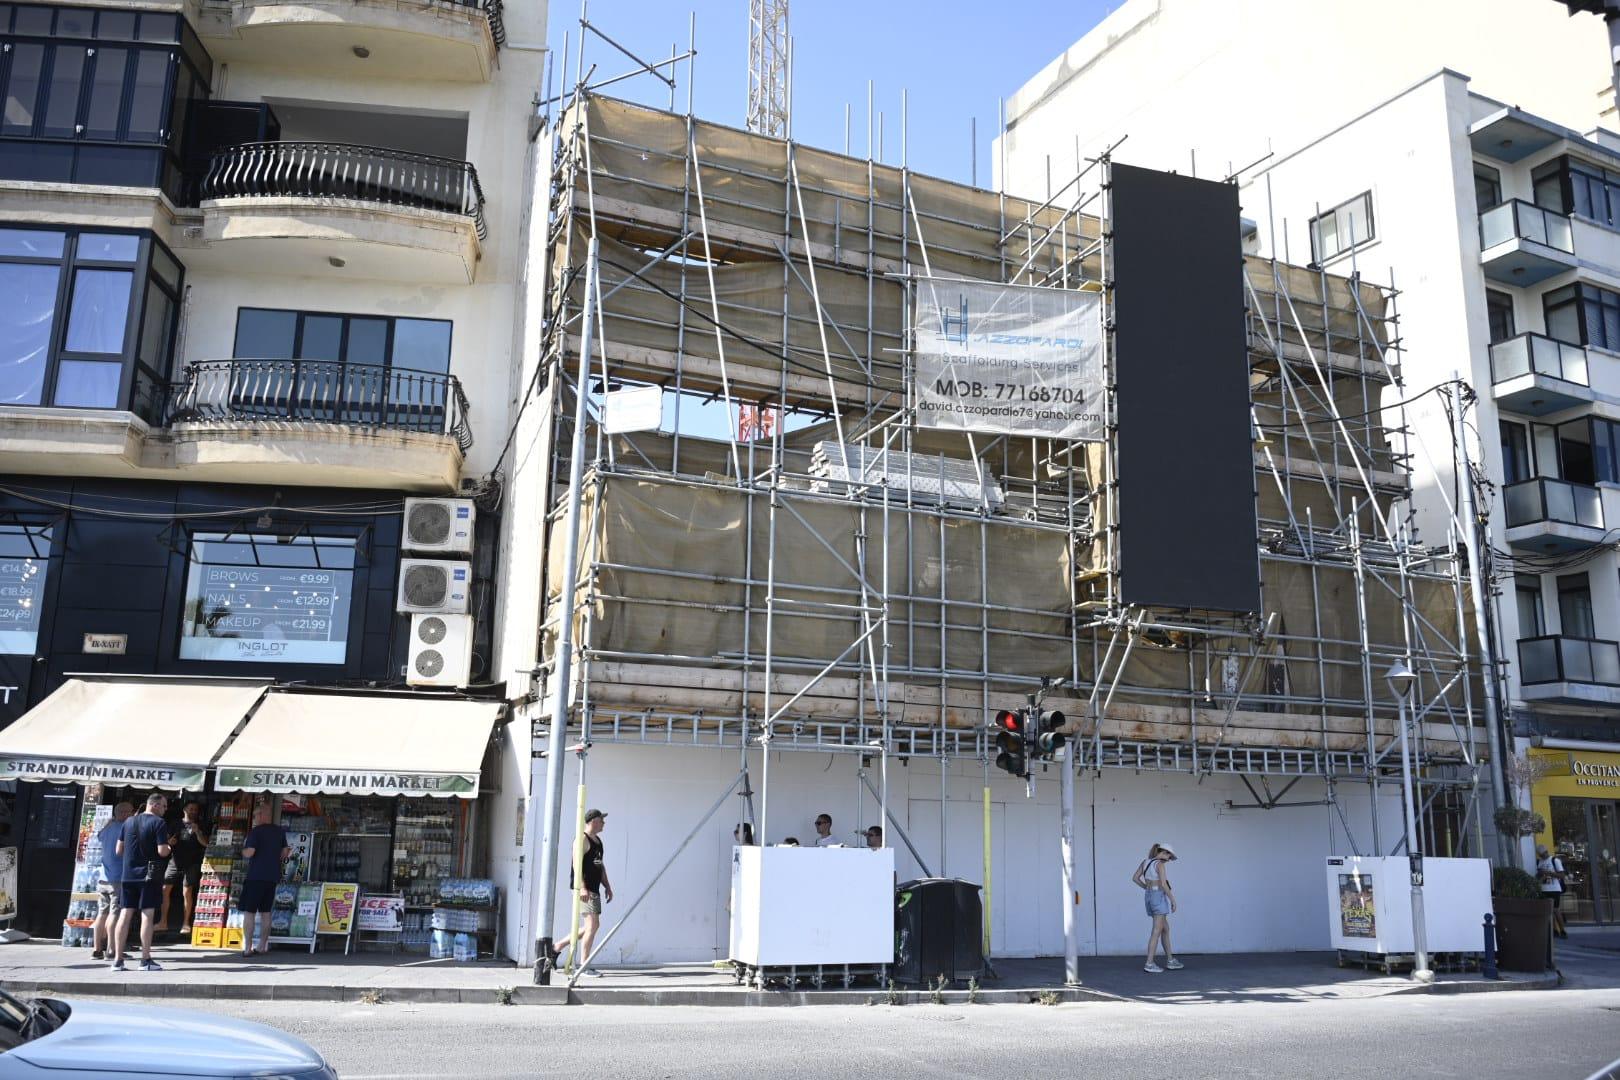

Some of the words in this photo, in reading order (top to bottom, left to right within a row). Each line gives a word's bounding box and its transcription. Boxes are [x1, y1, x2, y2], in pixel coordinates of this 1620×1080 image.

[974, 334, 1084, 349] AZZOPARDI
[942, 352, 1018, 370] Scaffolding
[1023, 359, 1079, 373] Services
[936, 379, 988, 398] MOB:
[995, 383, 1086, 405] 77168704
[209, 570, 260, 582] BROWS
[300, 574, 330, 584] €9.99
[207, 593, 247, 604] NAILS
[295, 596, 330, 606] €12.99
[205, 617, 262, 628] MAKEUP
[292, 619, 326, 630] €21.99
[238, 641, 289, 651] INGLOT
[7, 760, 70, 775] STRAND
[72, 765, 108, 778] MINI
[111, 767, 177, 782] MARKET
[252, 772, 323, 787] STRAND
[326, 774, 367, 788] MINI
[371, 775, 442, 790] MARKET
[359, 899, 388, 909] ICE
